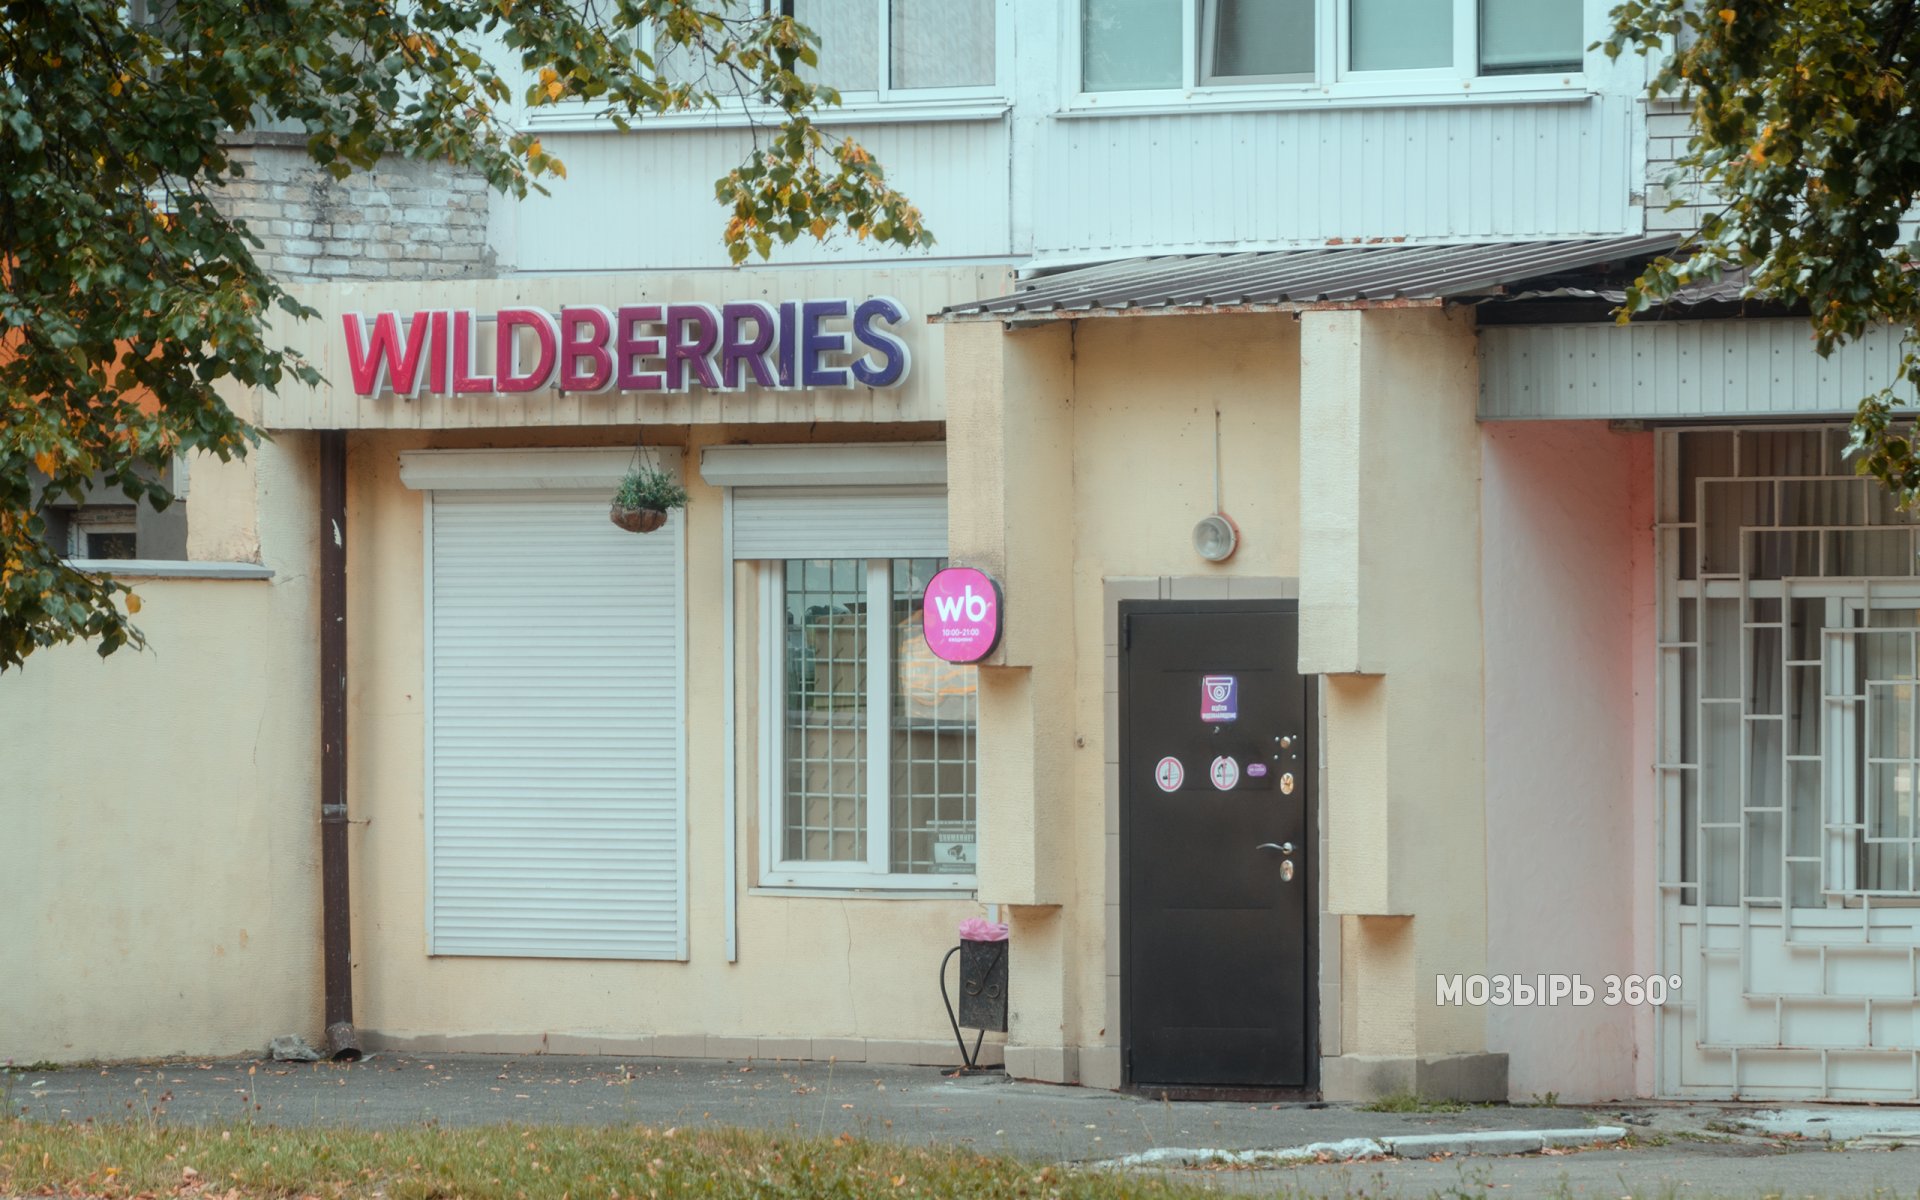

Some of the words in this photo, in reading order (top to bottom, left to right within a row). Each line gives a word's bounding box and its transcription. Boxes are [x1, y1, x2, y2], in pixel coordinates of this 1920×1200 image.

[342, 296, 910, 396] WILDBERRIES
[935, 585, 986, 622] wb
[942, 628, 980, 637] 10:00-21:00
